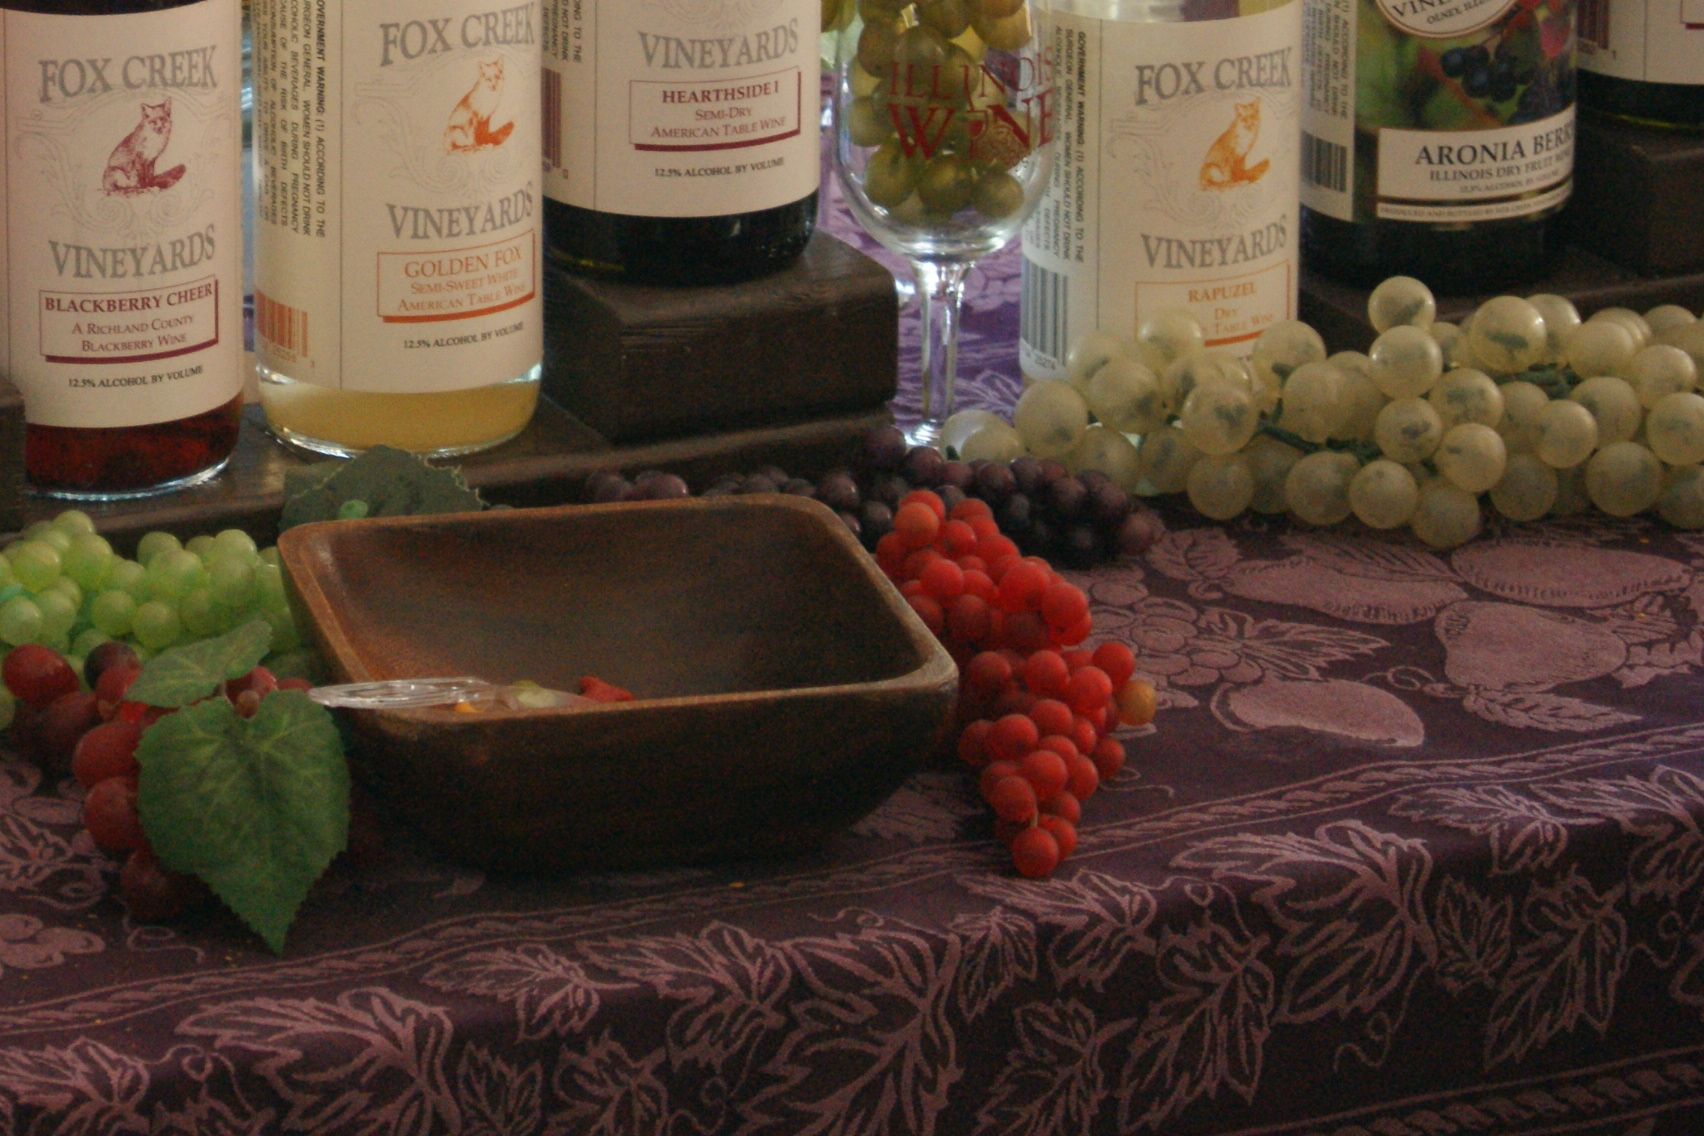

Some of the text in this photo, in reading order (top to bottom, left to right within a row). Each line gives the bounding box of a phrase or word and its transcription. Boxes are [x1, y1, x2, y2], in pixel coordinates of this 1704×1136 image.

[379, 2, 534, 67] FOX CREEK
[638, 19, 798, 69] VINEYARDS
[39, 46, 217, 102] FOX CREEK
[1135, 47, 1292, 105] FOX CREEK
[316, 66, 325, 116] WARNING:
[662, 84, 770, 105] HEARTHSIDE
[302, 100, 311, 138] WOMEN
[651, 115, 785, 140] AMERICAN TABLE WINE
[696, 106, 752, 121] SEMI-DRY
[291, 122, 299, 160] DURING
[1415, 119, 1574, 165] ARONIA BERR
[302, 140, 311, 180] SHOULD
[316, 136, 325, 195] ACCORDING
[655, 157, 784, 177] 12.5% ALCOHOL BY VOLUME
[1430, 169, 1492, 181] ILLINOIS
[1496, 167, 1521, 178] DRY
[302, 182, 311, 203] NOT
[316, 201, 325, 213] TO
[302, 205, 311, 235] DRINK
[385, 180, 532, 239] VINEYARDS
[316, 219, 325, 238] THE
[1141, 215, 1287, 269] VINEYARDS
[49, 224, 215, 279] VINEYARDS
[404, 245, 522, 278] GOLDEN FOX
[398, 283, 526, 311] AMERICAN TABLE WINE
[411, 269, 518, 295] SEMI-SWEET WHITE
[1188, 282, 1256, 302] RAPUZEL
[45, 283, 213, 313] BLACKBERRY CHEER
[72, 314, 194, 336] A RICHLAND COUNTY
[404, 321, 524, 349] 12.5% ALCOHOL BY VOLUME
[82, 332, 187, 353] BLACKBERRY WINE
[68, 366, 203, 388] 12.5% ALCOHOL BY VOLUME
